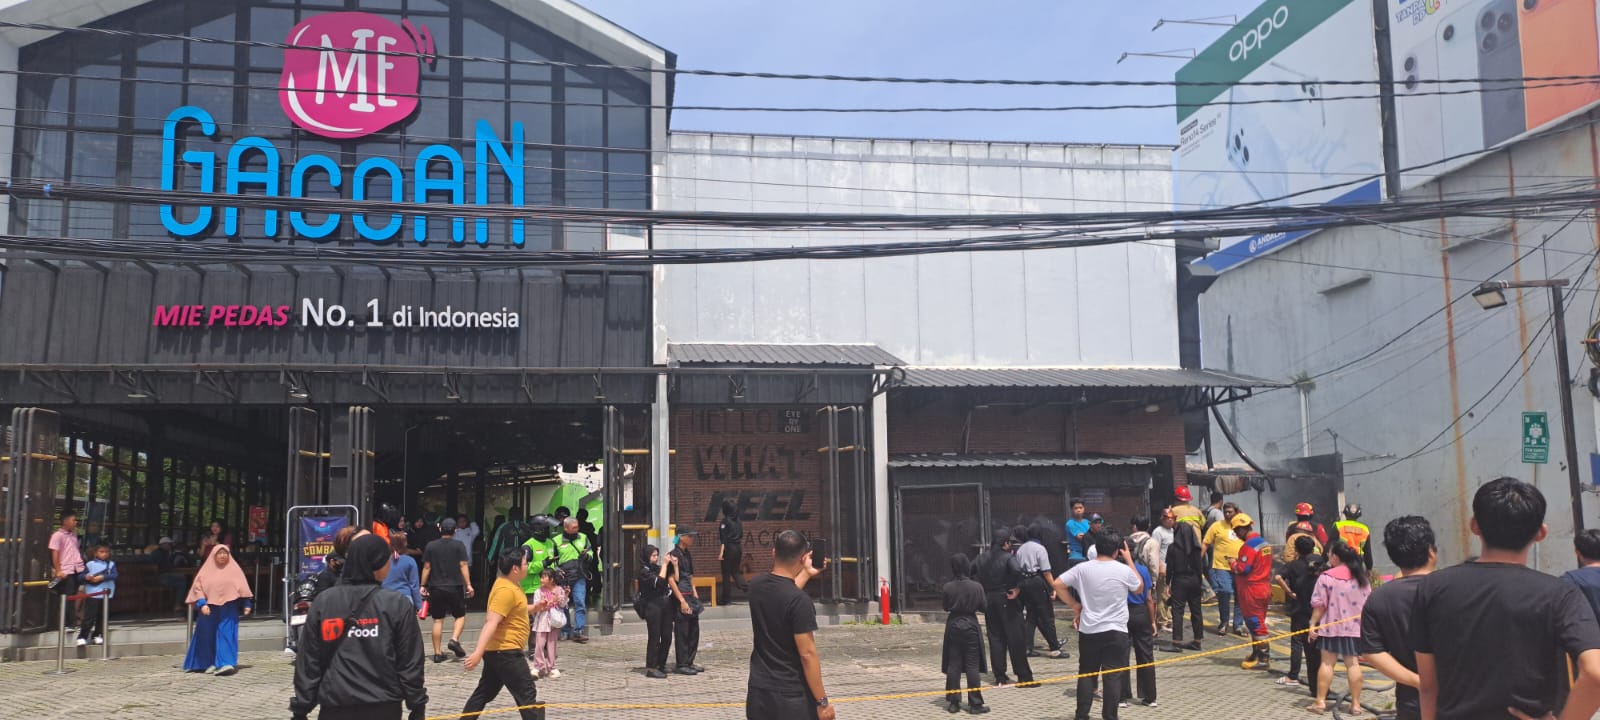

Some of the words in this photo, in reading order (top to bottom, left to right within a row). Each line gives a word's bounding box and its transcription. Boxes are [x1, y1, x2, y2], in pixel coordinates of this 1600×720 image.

[315, 28, 398, 113] MIE
[160, 105, 524, 245] GACOAN
[152, 305, 203, 327] MIE
[208, 305, 289, 327] PEDAS
[301, 297, 355, 328] No.
[366, 298, 383, 327] 1
[392, 306, 413, 328] di
[419, 306, 520, 328] Indonesia
[347, 625, 379, 638] Food
